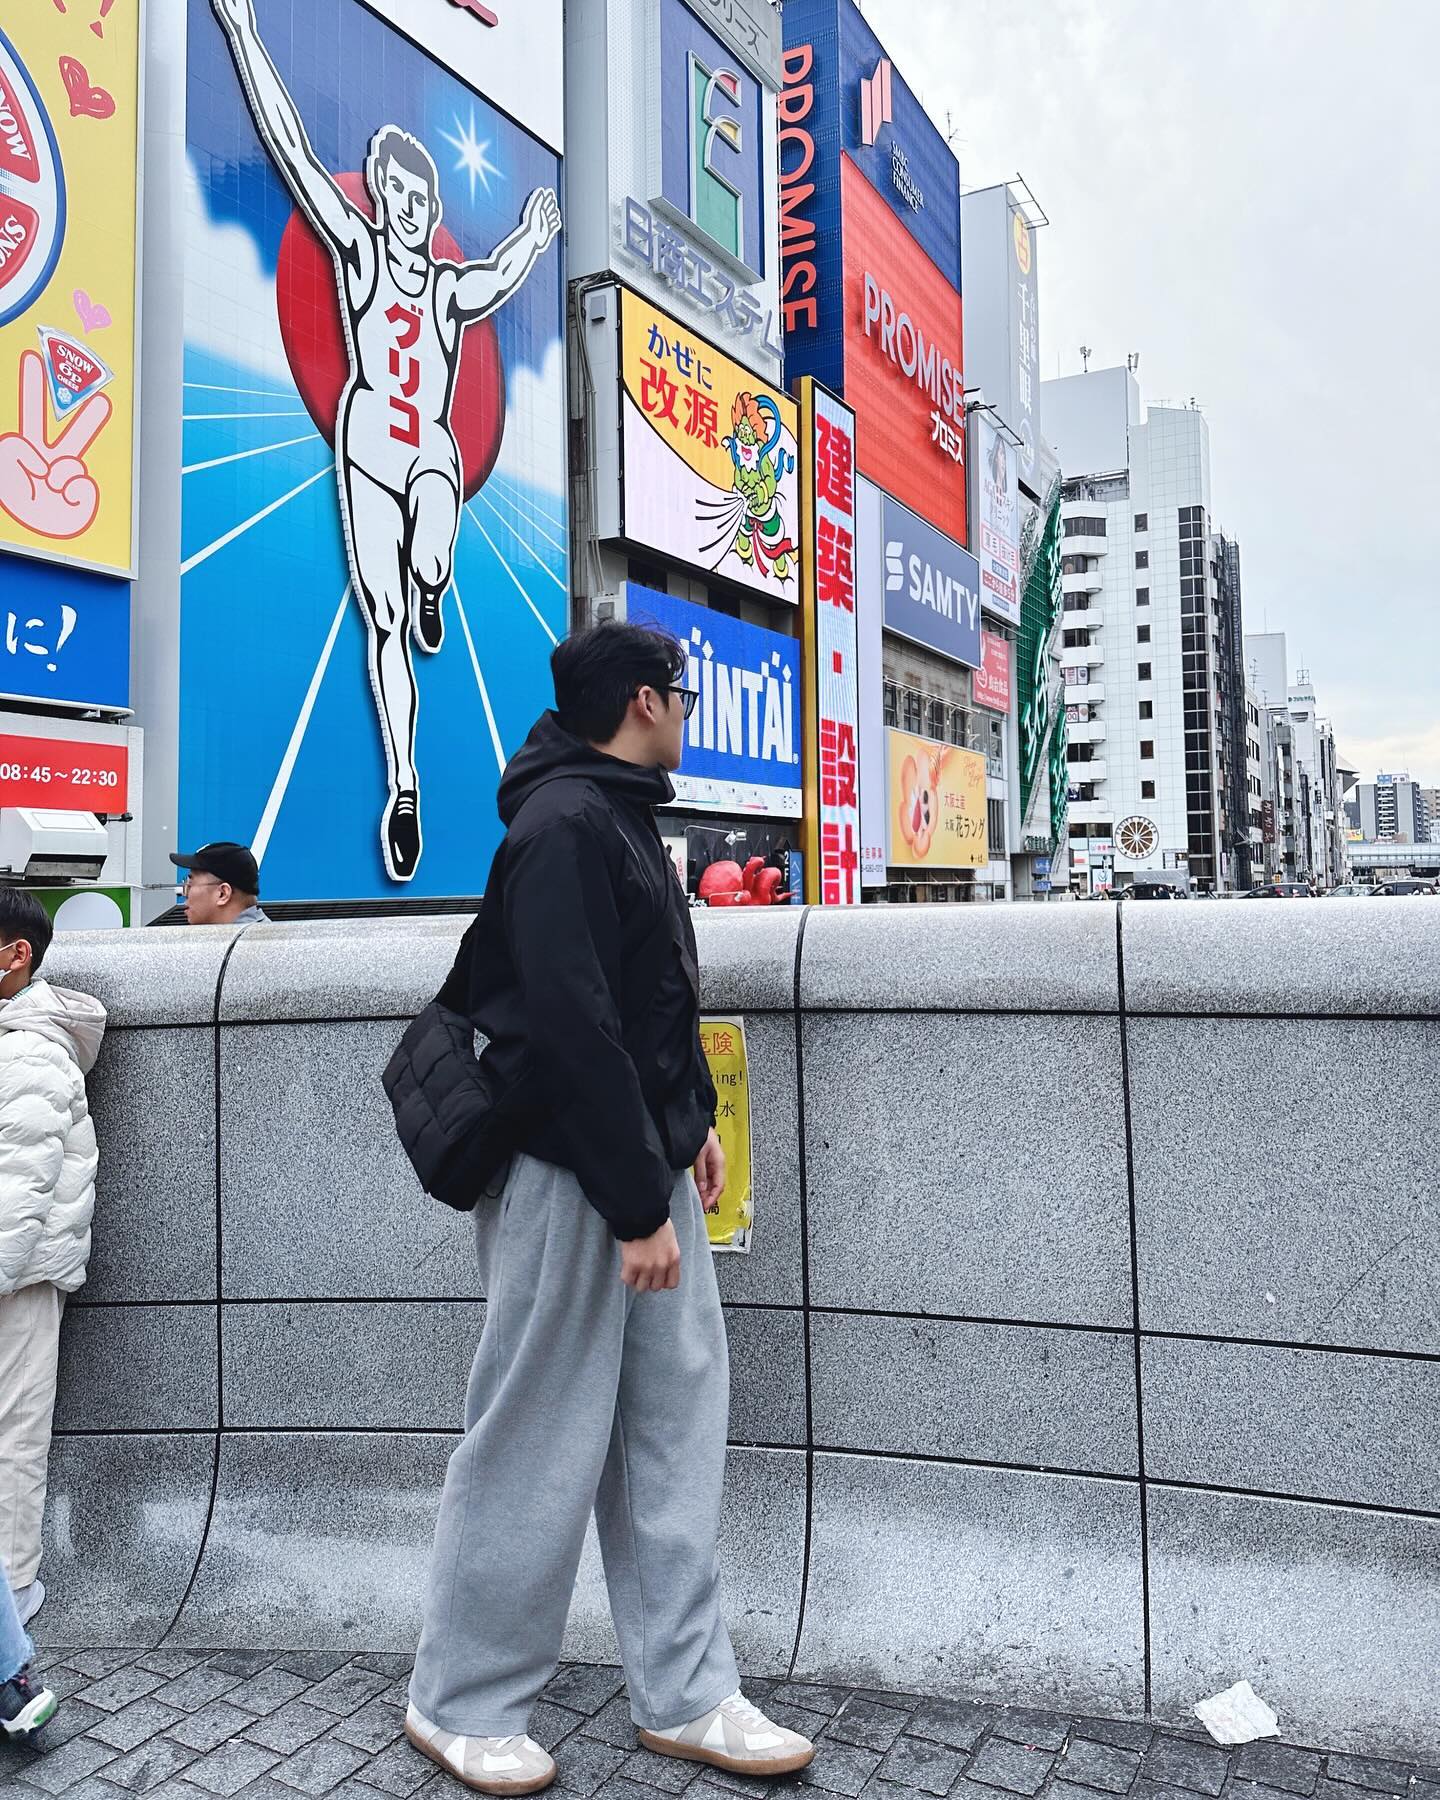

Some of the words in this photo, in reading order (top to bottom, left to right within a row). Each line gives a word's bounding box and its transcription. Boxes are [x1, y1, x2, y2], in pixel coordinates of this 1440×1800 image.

[777, 44, 817, 332] PROMISE
[56, 344, 94, 374] SNOW
[58, 362, 83, 384] 6P
[384, 302, 424, 448] グリコ
[647, 322, 713, 391] かぜに
[864, 271, 964, 429] PROMISE
[57, 373, 81, 392] CHEESE
[639, 356, 719, 449] 改源
[930, 410, 964, 466] プロミス
[908, 553, 978, 632] SAMTY
[6, 604, 77, 672] に!
[783, 850, 790, 882] 2F
[710, 1069, 743, 1087] ing!
[713, 1100, 736, 1118] 水
